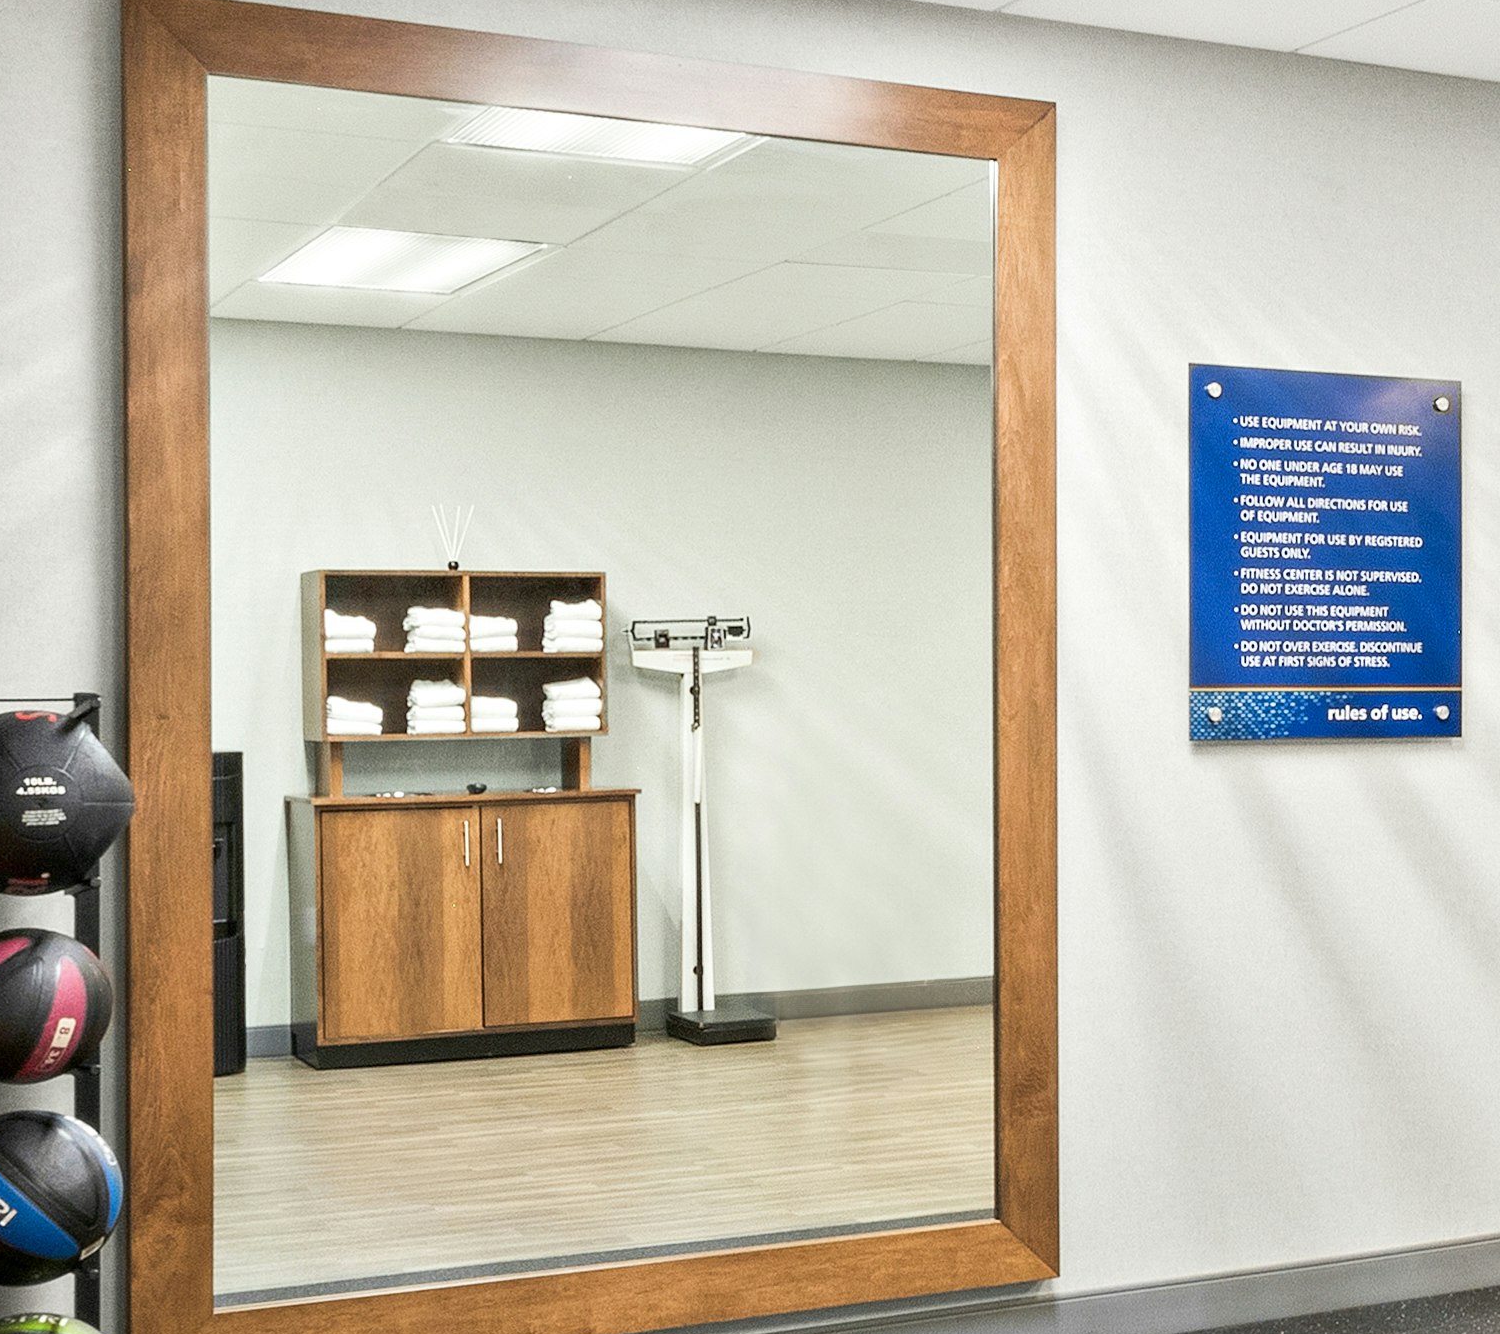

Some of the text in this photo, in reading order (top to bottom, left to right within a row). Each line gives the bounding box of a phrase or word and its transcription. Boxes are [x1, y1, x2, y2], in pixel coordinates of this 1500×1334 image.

[1240, 415, 1422, 436] USE EQUIPMENT AT YOUR OWN RISK.
[1240, 436, 1422, 457] IMPROPER USE CAN RESULT IN INJURY.
[1240, 458, 1404, 477] NO ONE UNDER AGE 18 MAY USE
[1240, 473, 1325, 488] THE EQUIPMENT.
[1240, 494, 1409, 512] FOLLOW ALL DIRECTIONS FOR USE
[1240, 509, 1320, 523] OF EQUIPMENT.
[1240, 531, 1423, 548] EQUIPMENT FOR USE BY REGISTERED
[1240, 546, 1311, 559] GUESTS ONLY.
[1240, 567, 1422, 583] FITNESS CENTER IS NOT SUPERVISED.
[1240, 583, 1370, 596] DO NOT EXERCISE ALONE.
[1240, 604, 1389, 618] DO NOT USE THIS EQUIPMENT
[1240, 618, 1407, 632] WITHOUT DOCTOR'S PERMISSION.
[1240, 640, 1423, 653] DO NOT OVER EXERCISE. DISCONTINUE
[1240, 655, 1391, 668] USE AT FIRST SIGNS OF STRESS.
[1327, 704, 1423, 721] rules of use.
